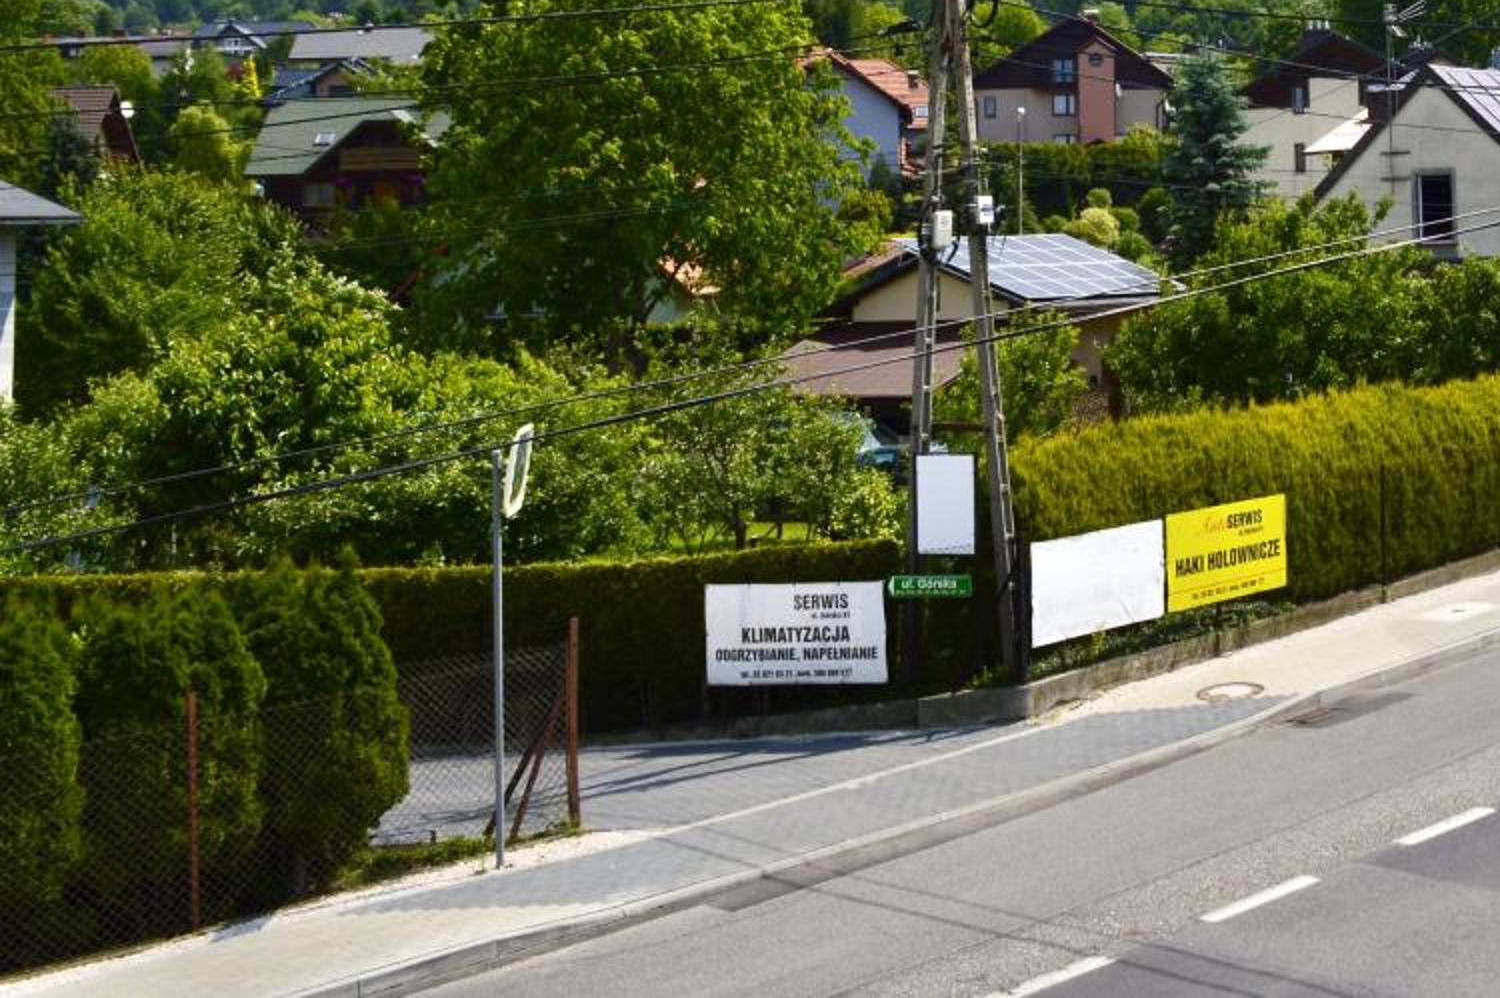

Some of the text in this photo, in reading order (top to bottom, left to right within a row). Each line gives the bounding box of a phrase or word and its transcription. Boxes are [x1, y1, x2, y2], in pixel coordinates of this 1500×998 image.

[1227, 508, 1263, 529] SERWIS
[1175, 538, 1281, 578] HAKI HOLOWNICZE
[793, 593, 849, 610] SERWIS
[741, 625, 850, 643] KLIMATYZACJA
[803, 646, 878, 660] NAPEŁNIANIE
